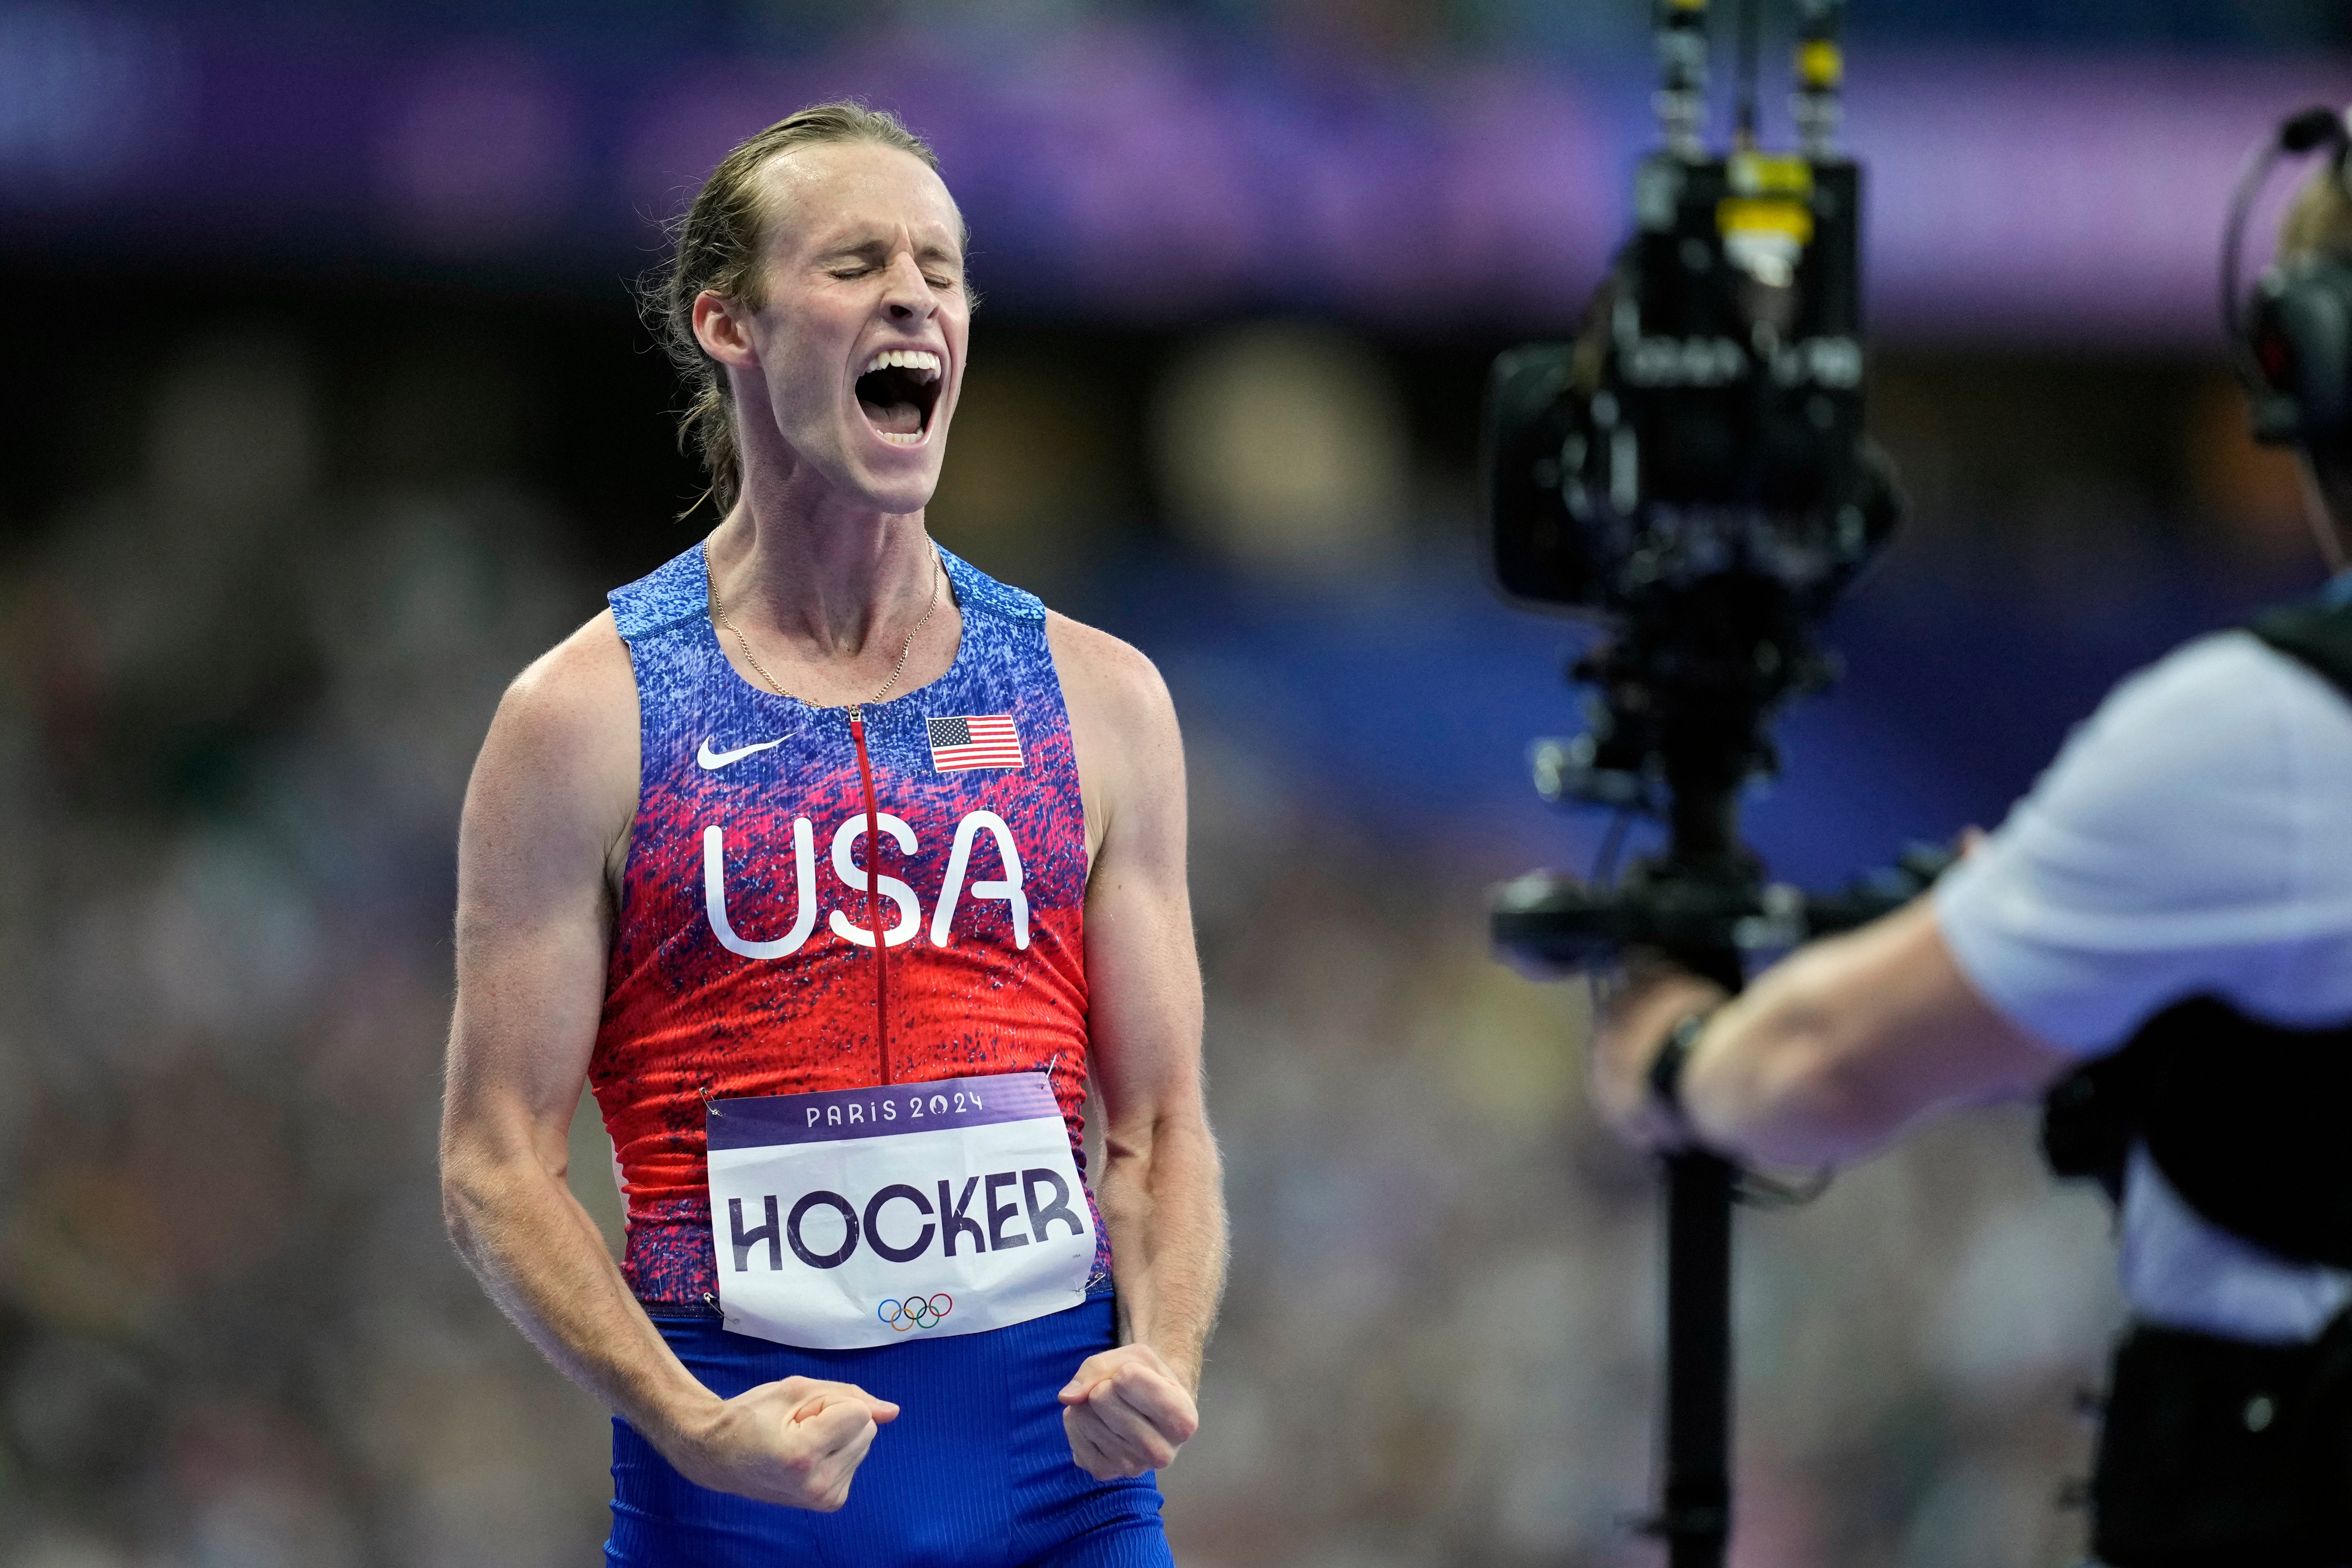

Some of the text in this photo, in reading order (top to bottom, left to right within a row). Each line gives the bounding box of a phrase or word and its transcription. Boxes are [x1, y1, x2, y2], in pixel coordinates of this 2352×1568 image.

[703, 810, 1030, 960] USA
[910, 1091, 983, 1118] 2024
[728, 1168, 1084, 1272] HOCKER
